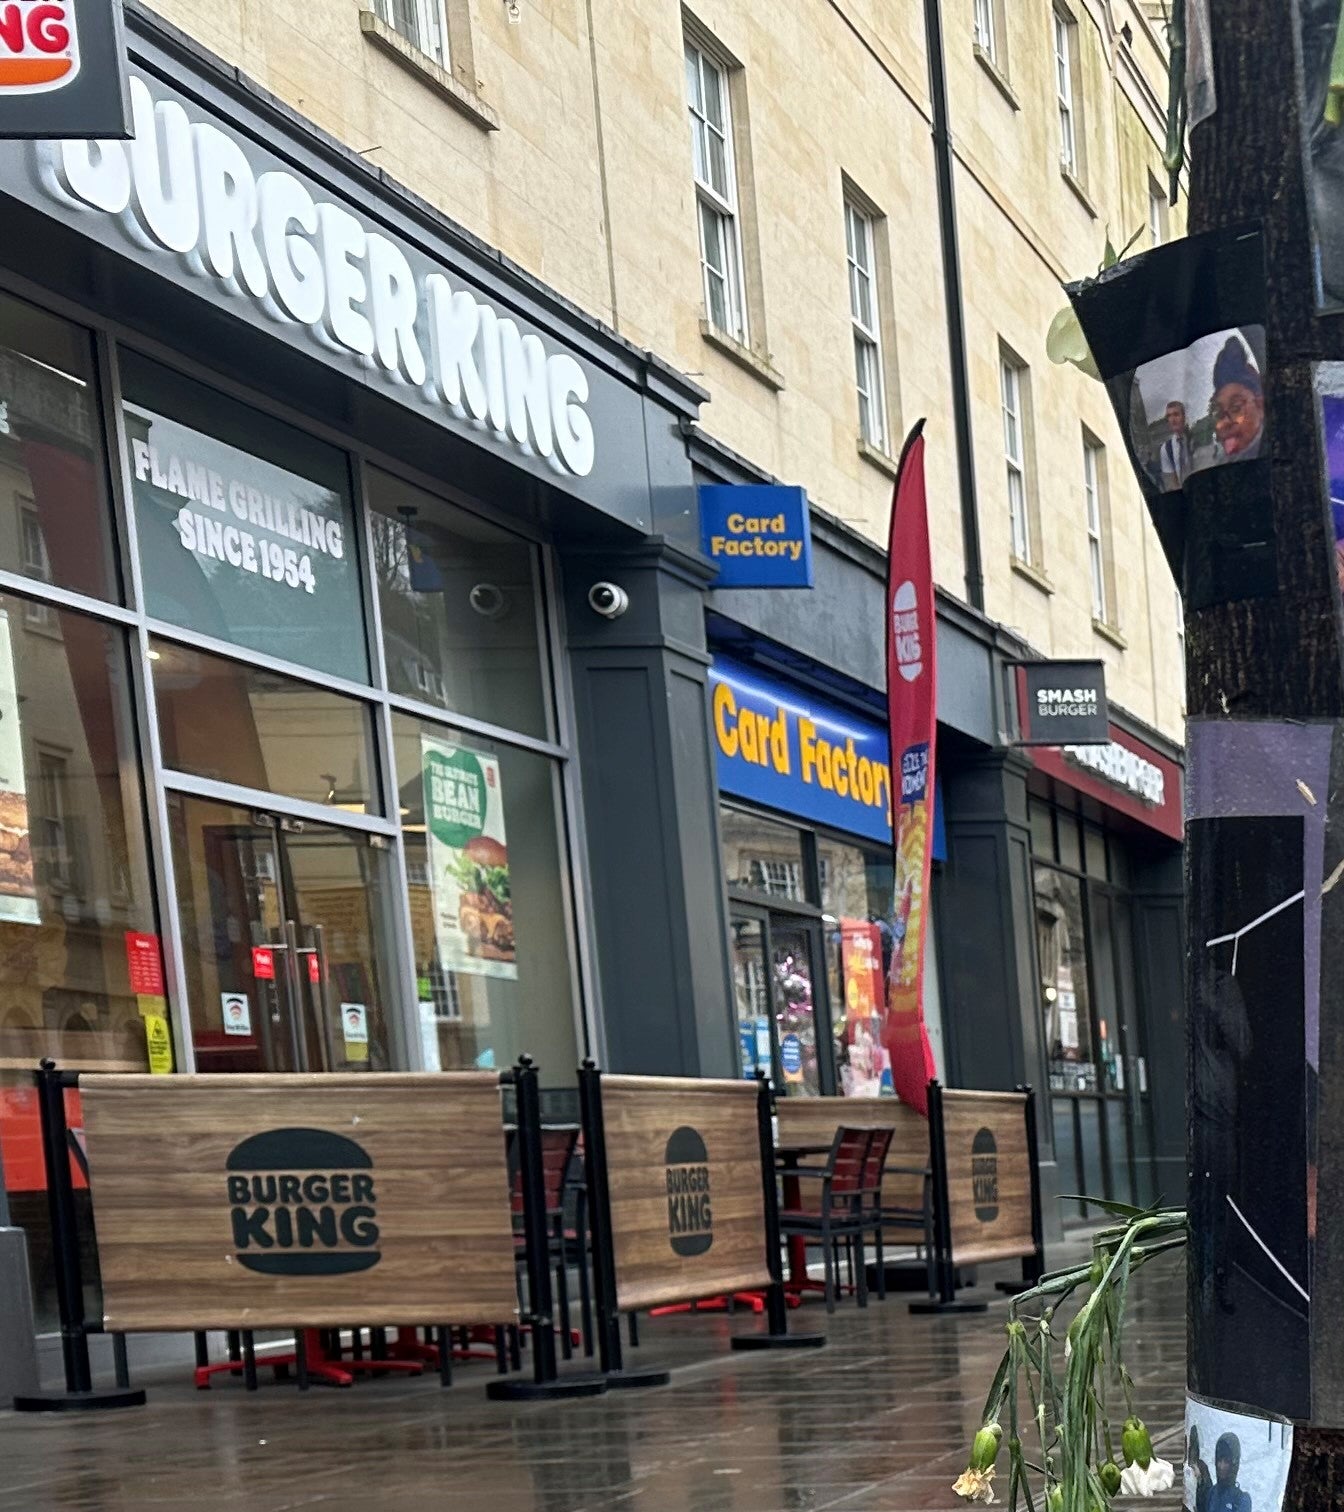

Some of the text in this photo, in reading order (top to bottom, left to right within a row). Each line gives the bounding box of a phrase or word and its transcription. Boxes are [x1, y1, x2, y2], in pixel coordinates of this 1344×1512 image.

[424, 272, 595, 477] KING
[132, 437, 344, 559] FLAME GRILLING
[727, 513, 785, 534] Card
[178, 507, 316, 594] SINCE 1954
[711, 535, 803, 561] Factory
[1037, 689, 1097, 703] SMASH
[1038, 703, 1098, 716] BURGER
[713, 682, 791, 775] Card
[431, 775, 480, 813] BEAN
[227, 1174, 376, 1204] BURGER
[666, 1166, 710, 1194] BURGER
[230, 1205, 380, 1248] KING
[668, 1194, 711, 1233] KING
